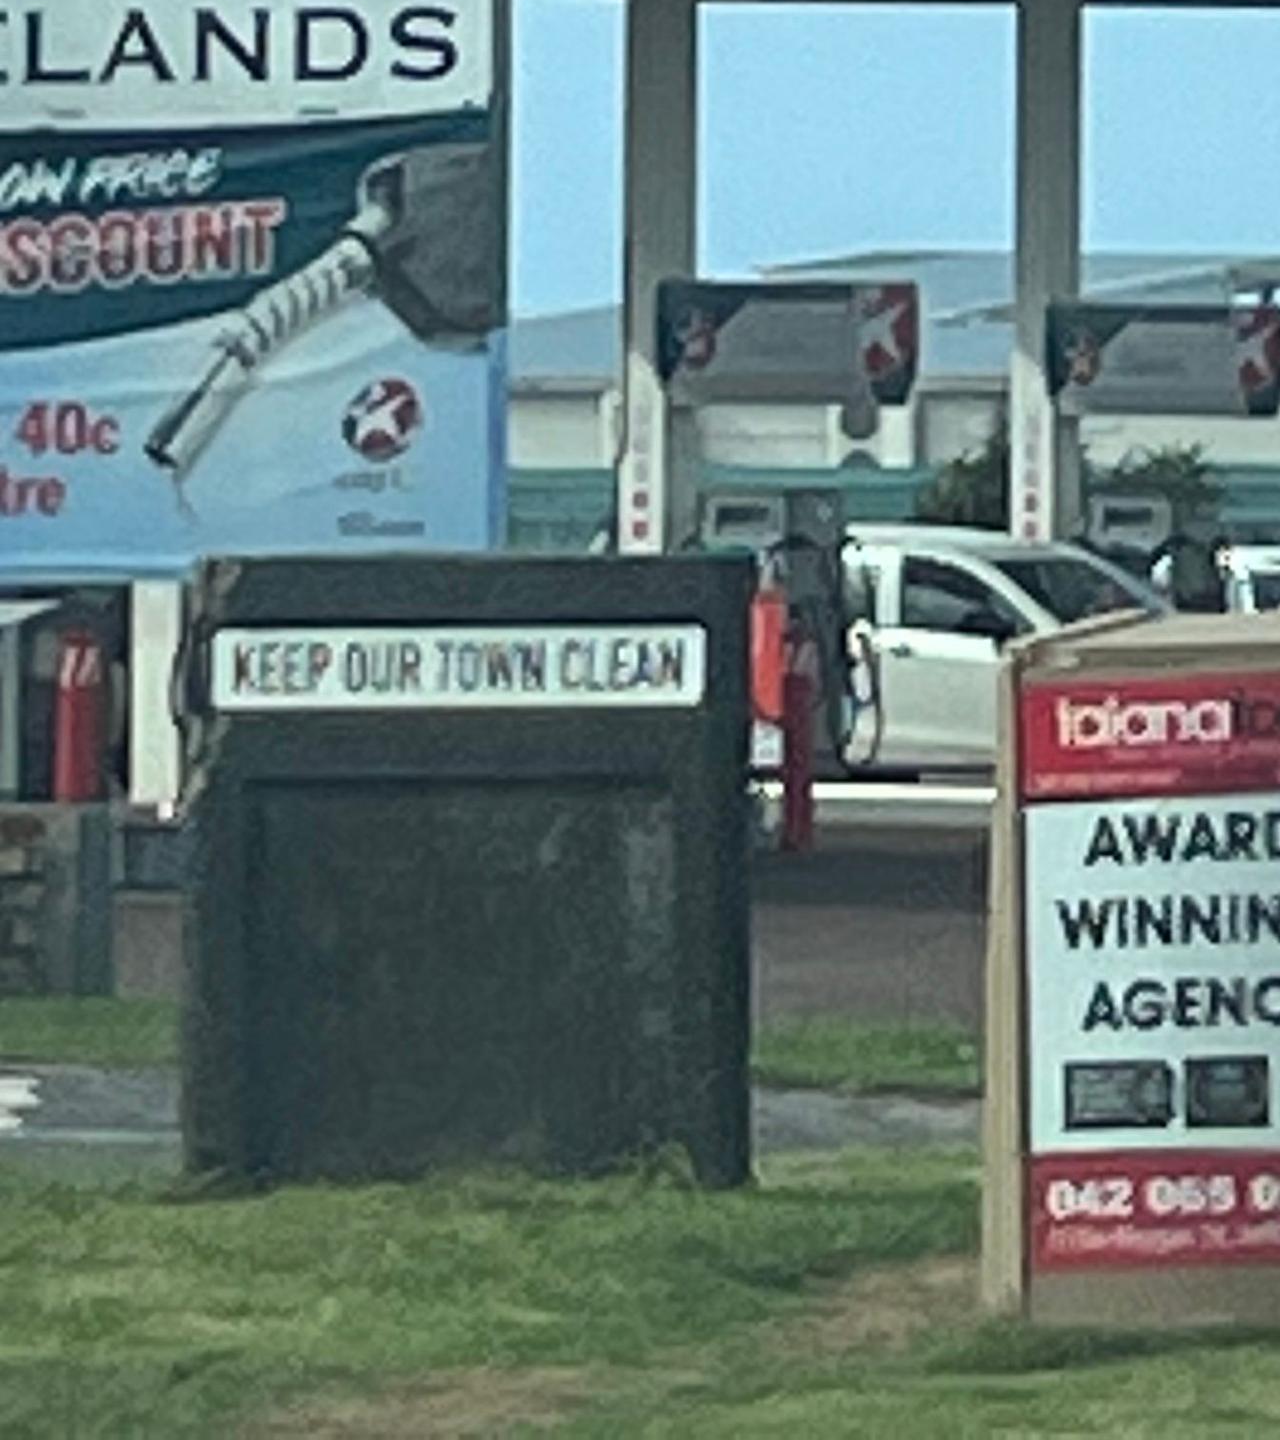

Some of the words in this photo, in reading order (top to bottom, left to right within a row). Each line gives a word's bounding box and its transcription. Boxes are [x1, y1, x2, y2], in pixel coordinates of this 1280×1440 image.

[0, 6, 460, 83] LANDS
[15, 401, 120, 457] 40c
[231, 642, 332, 694] KEEP
[345, 641, 421, 693] OUR
[433, 639, 547, 693] TOWN
[558, 638, 686, 692] CLEAN
